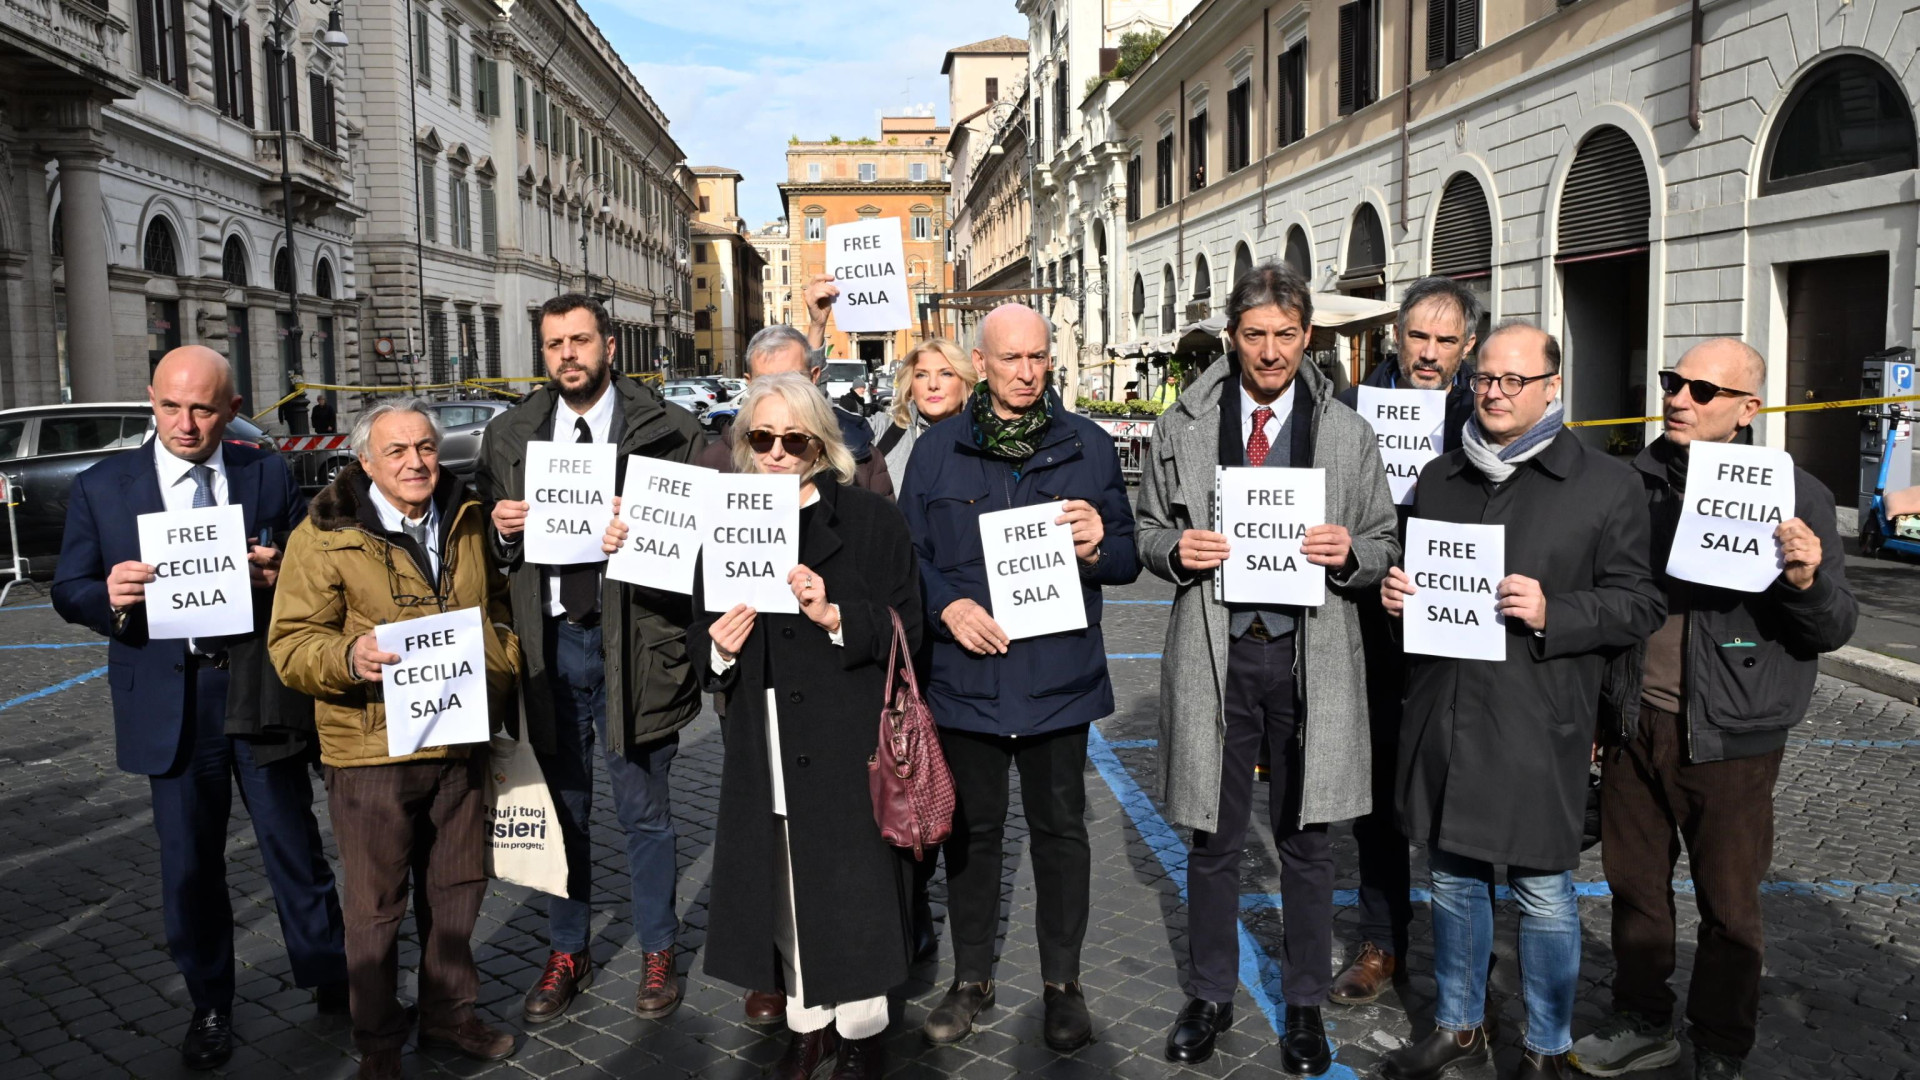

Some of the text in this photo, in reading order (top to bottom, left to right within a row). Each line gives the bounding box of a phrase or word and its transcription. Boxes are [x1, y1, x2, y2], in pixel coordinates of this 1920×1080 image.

[843, 235, 881, 252] FREE
[834, 261, 895, 281] CECILIA
[848, 290, 889, 307] SALA
[1897, 366, 1910, 385] P
[1377, 405, 1420, 421] FREE
[1376, 433, 1432, 451] ECILIA
[547, 457, 592, 475] FREE
[1386, 463, 1419, 480] ALA
[1717, 463, 1773, 486] FREE
[647, 476, 692, 498] FREE
[535, 488, 603, 506] CECILIA
[727, 493, 773, 510] FREE
[1247, 490, 1295, 506] FREE
[630, 504, 697, 531] CECILIA
[1696, 498, 1783, 523] CECILIA
[167, 525, 218, 544] FREE
[546, 518, 591, 535] SALA
[713, 527, 786, 545] CECILIA
[1003, 521, 1048, 544] FREE
[1233, 522, 1306, 540] CECILIA
[634, 536, 680, 559] SALA
[1428, 540, 1476, 559] FREE
[1701, 532, 1760, 556] SALA
[156, 556, 236, 578] CECILIA
[725, 561, 775, 579] SALA
[997, 551, 1065, 578] CECILIA
[1246, 555, 1297, 572] SALA
[1415, 571, 1491, 594] CECILIA
[171, 588, 226, 610] SALA
[1013, 584, 1060, 607] SALA
[1427, 605, 1479, 626] SALA
[405, 629, 456, 652] FREE
[394, 661, 473, 686] CECILIA
[410, 693, 462, 719] SALA
[491, 806, 510, 820] qui
[513, 805, 517, 817] i
[519, 806, 545, 819] tuoi
[484, 817, 546, 840] nsieri
[500, 841, 509, 849] in
